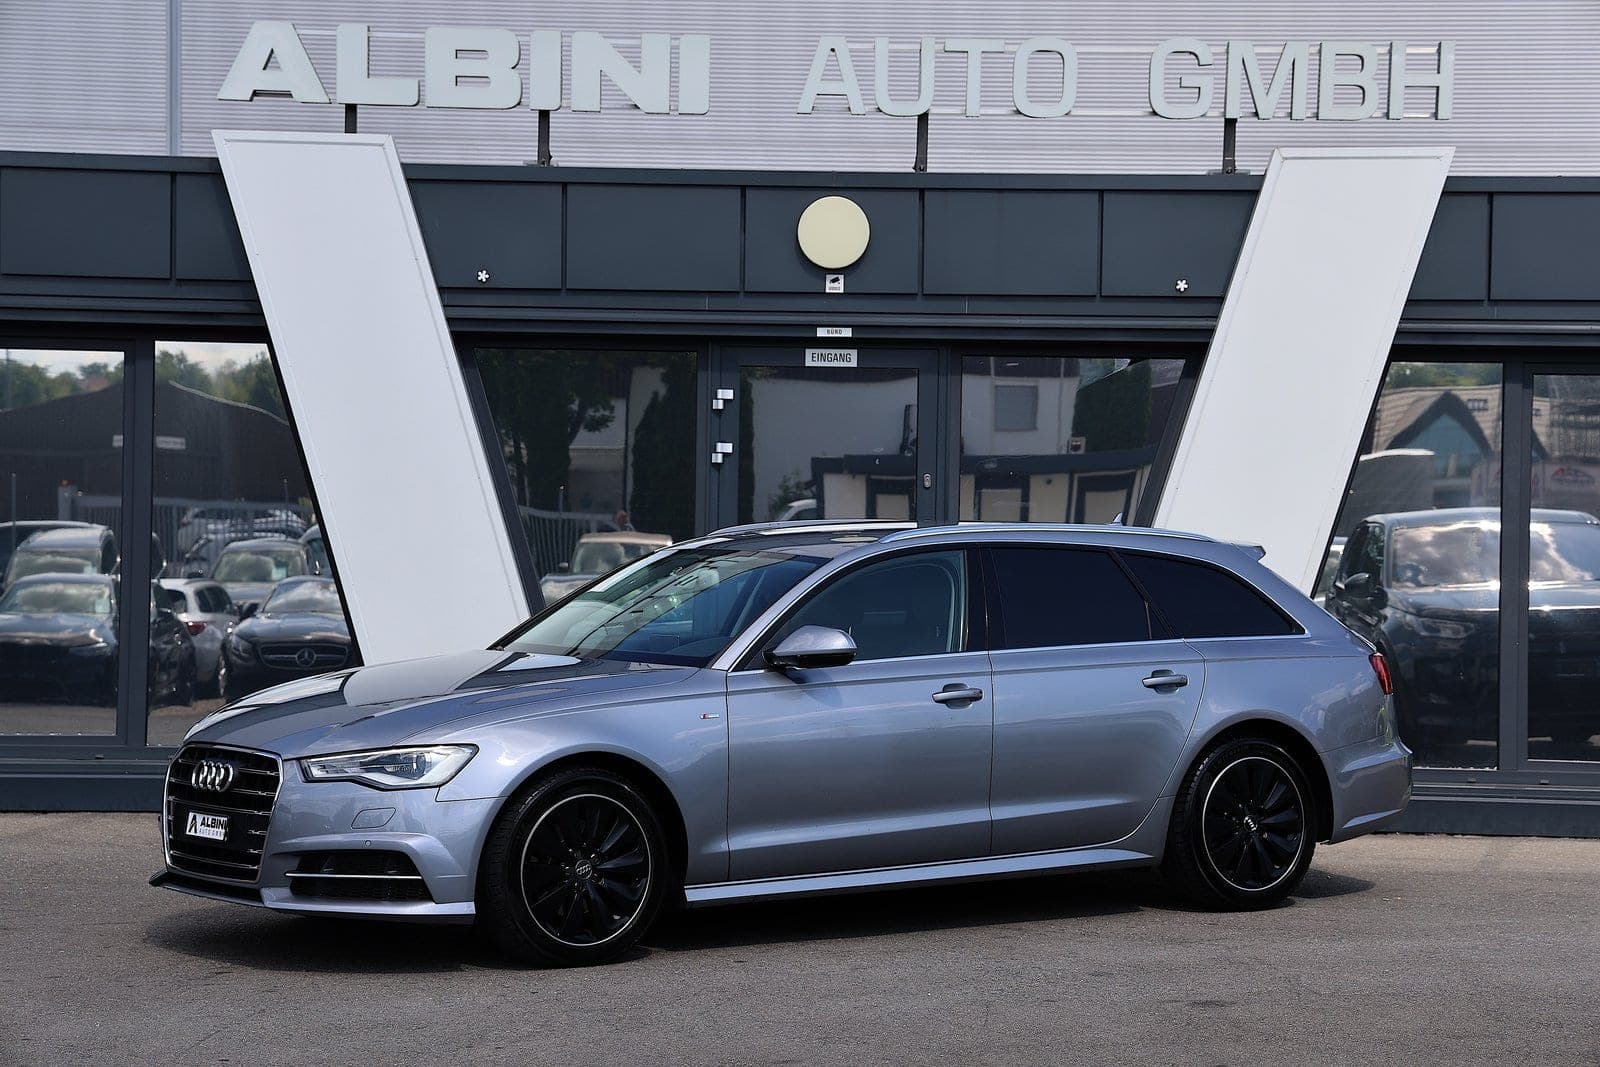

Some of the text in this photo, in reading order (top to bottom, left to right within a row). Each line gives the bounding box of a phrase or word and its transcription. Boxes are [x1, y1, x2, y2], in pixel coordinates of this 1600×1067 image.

[217, 21, 1456, 120] ALBINI AUTO GMBH
[811, 352, 852, 363] EINGANG
